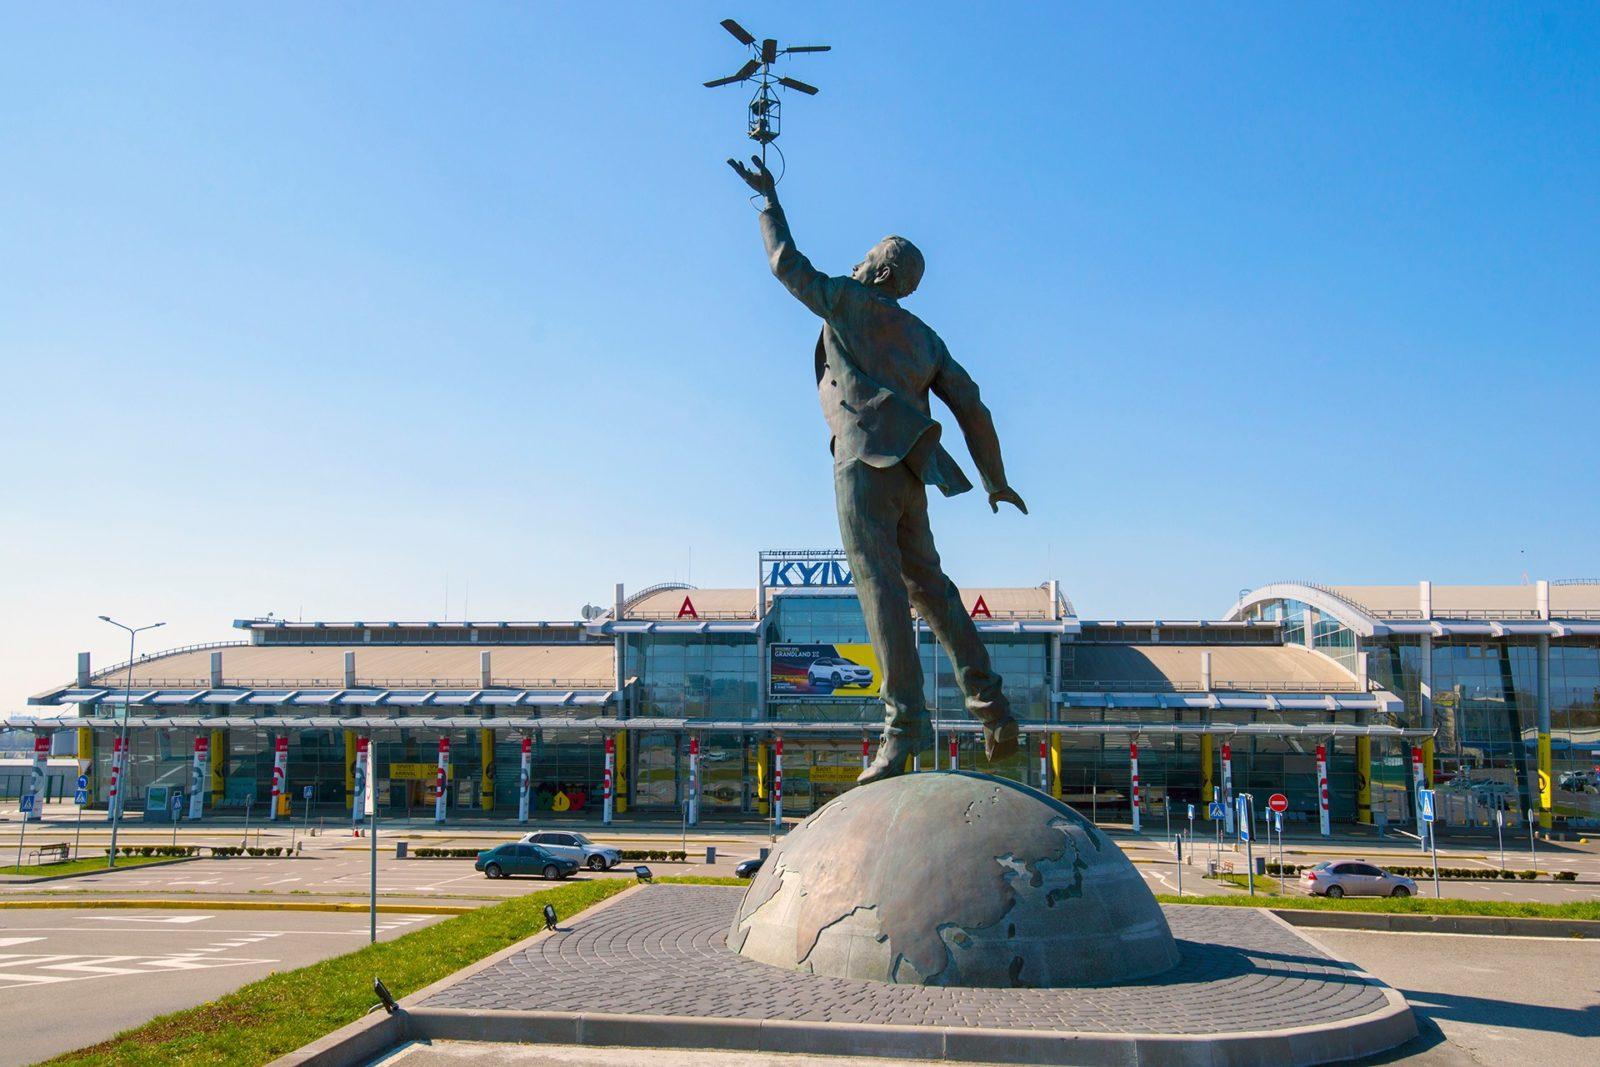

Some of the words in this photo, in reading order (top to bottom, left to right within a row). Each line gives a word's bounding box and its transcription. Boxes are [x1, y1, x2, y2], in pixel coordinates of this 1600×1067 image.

[770, 561, 852, 586] KYIV
[677, 595, 698, 618] A
[970, 594, 992, 618] A
